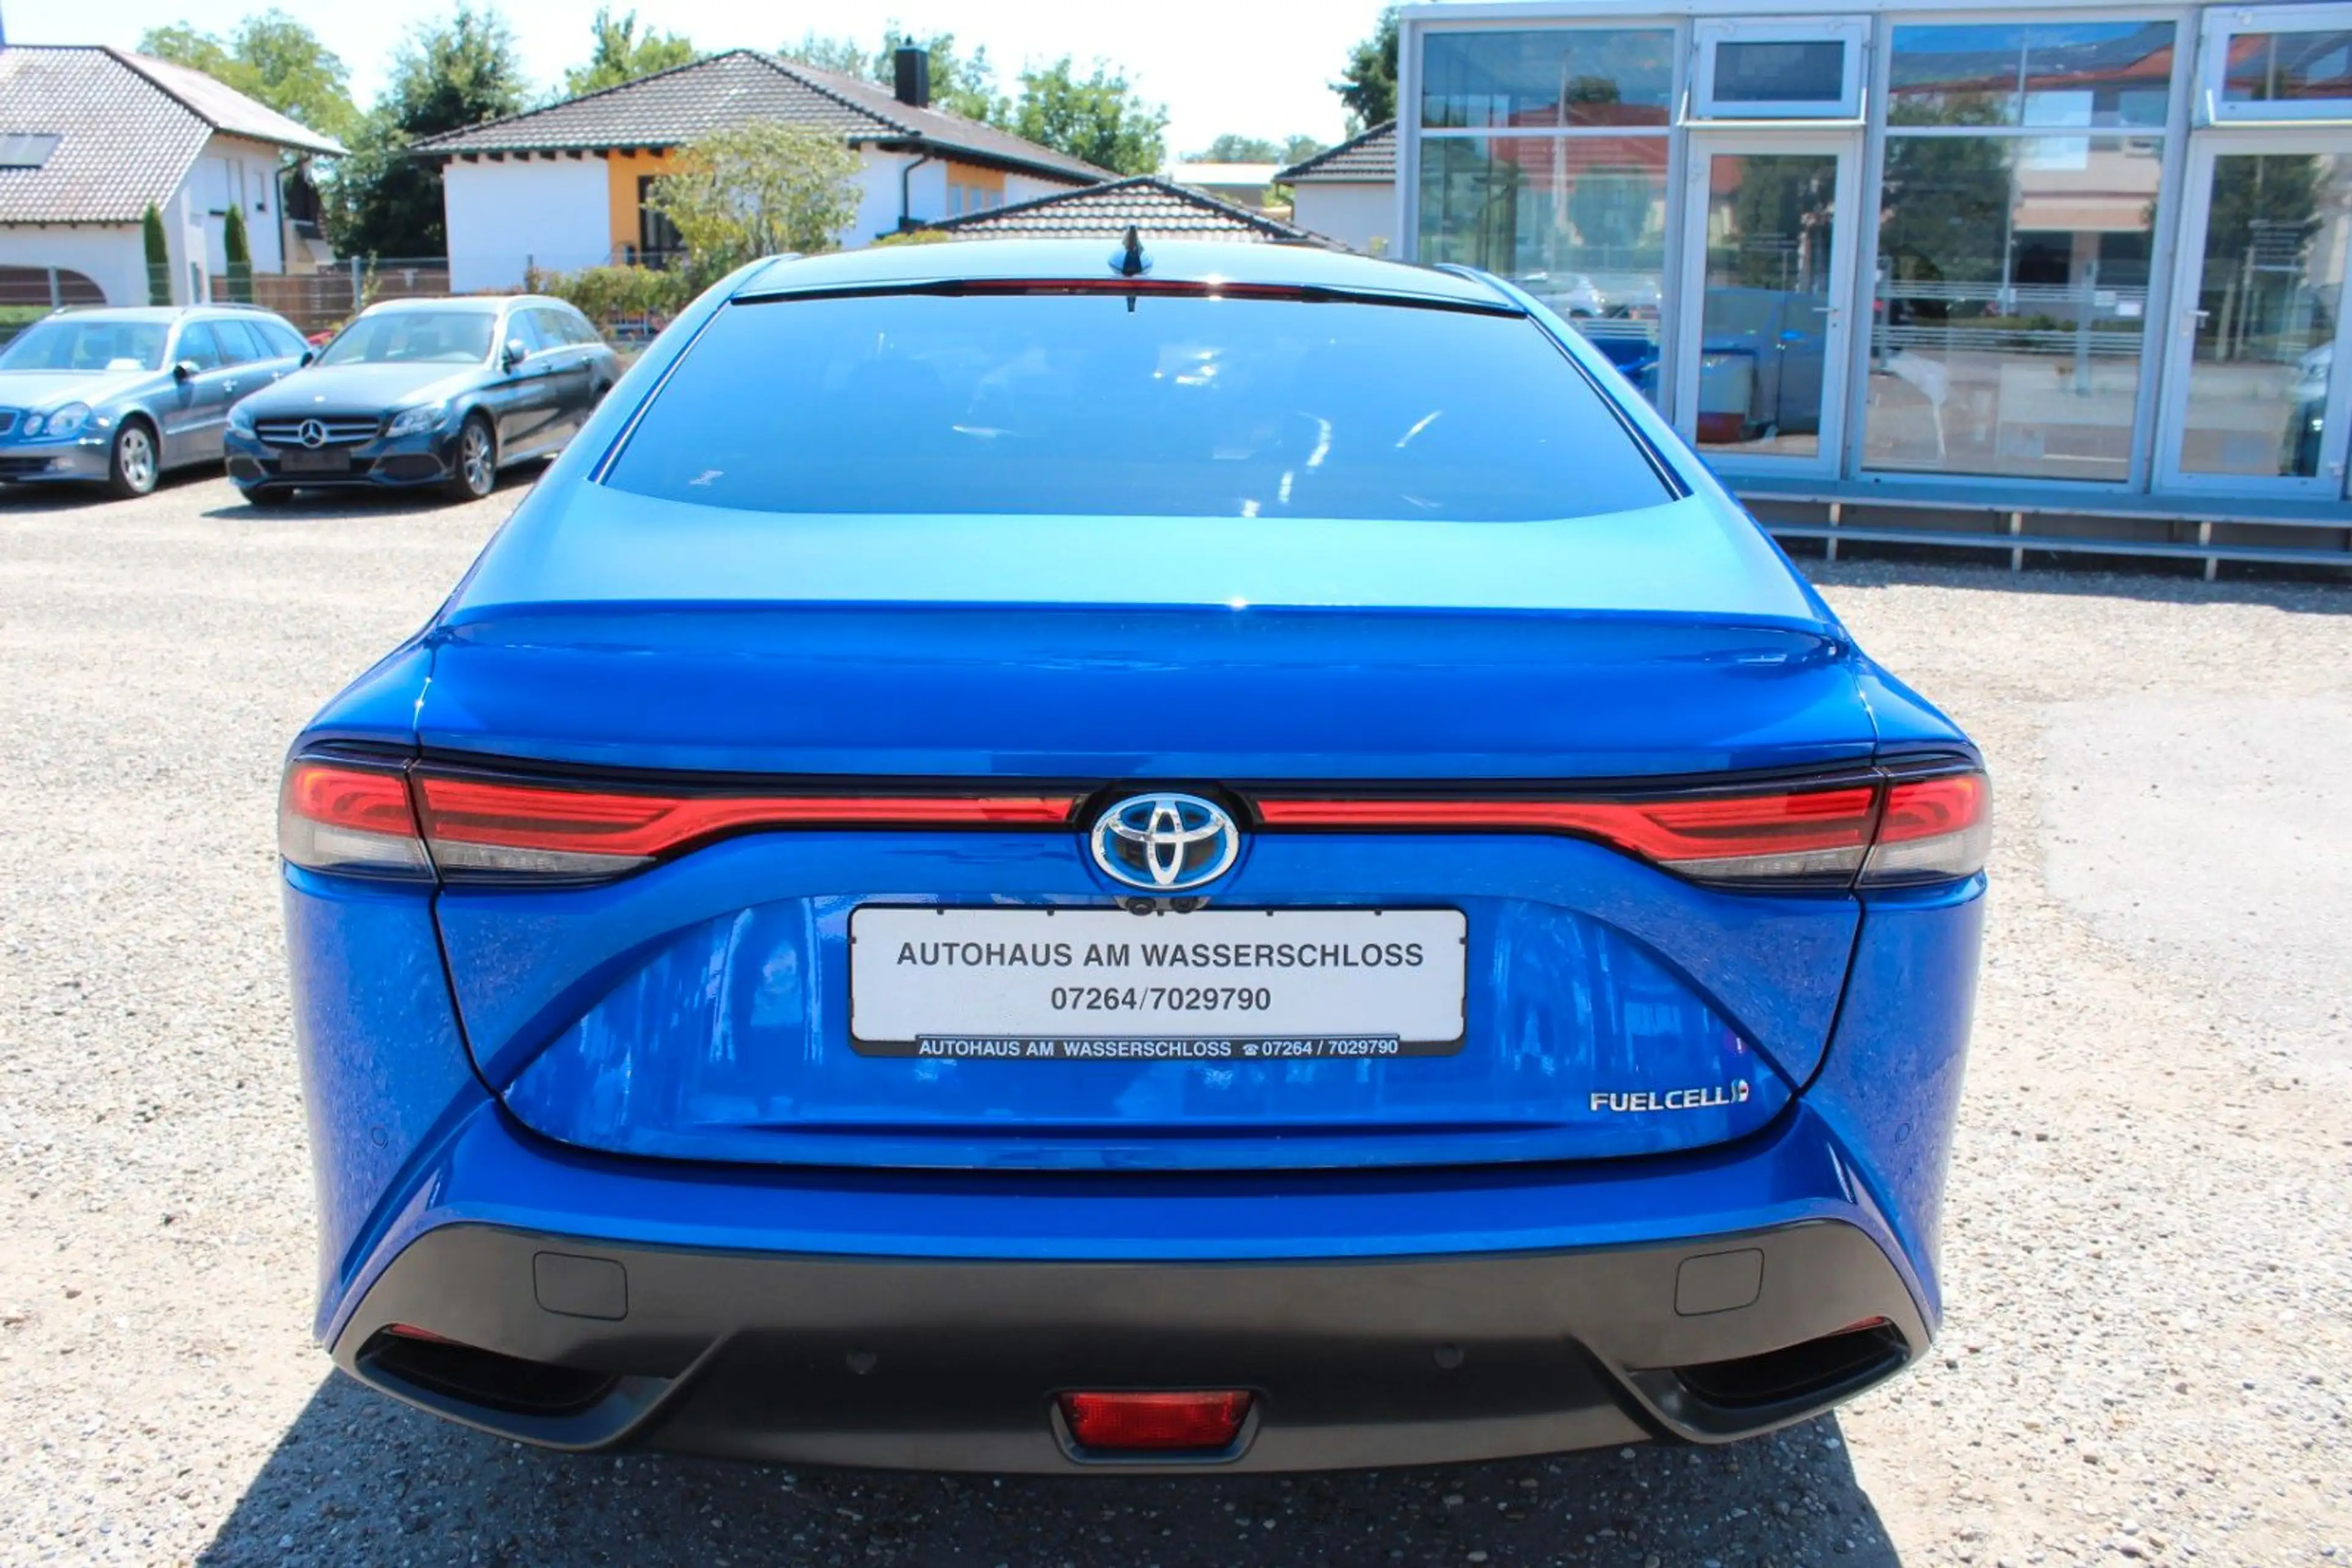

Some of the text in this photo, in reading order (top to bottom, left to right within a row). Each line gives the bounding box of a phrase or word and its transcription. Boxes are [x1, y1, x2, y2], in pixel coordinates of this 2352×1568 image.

[897, 941, 1423, 967] AUTOHAUS AM WASSERSCHLOSS
[1051, 987, 1271, 1010] 07264/7029790
[919, 1040, 1020, 1057] AUTOHAUS
[1026, 1041, 1054, 1057] AM
[1064, 1041, 1231, 1057] WASSERSCHLOSS
[1262, 1041, 1313, 1055] 07264
[1328, 1039, 1398, 1055] 7029790
